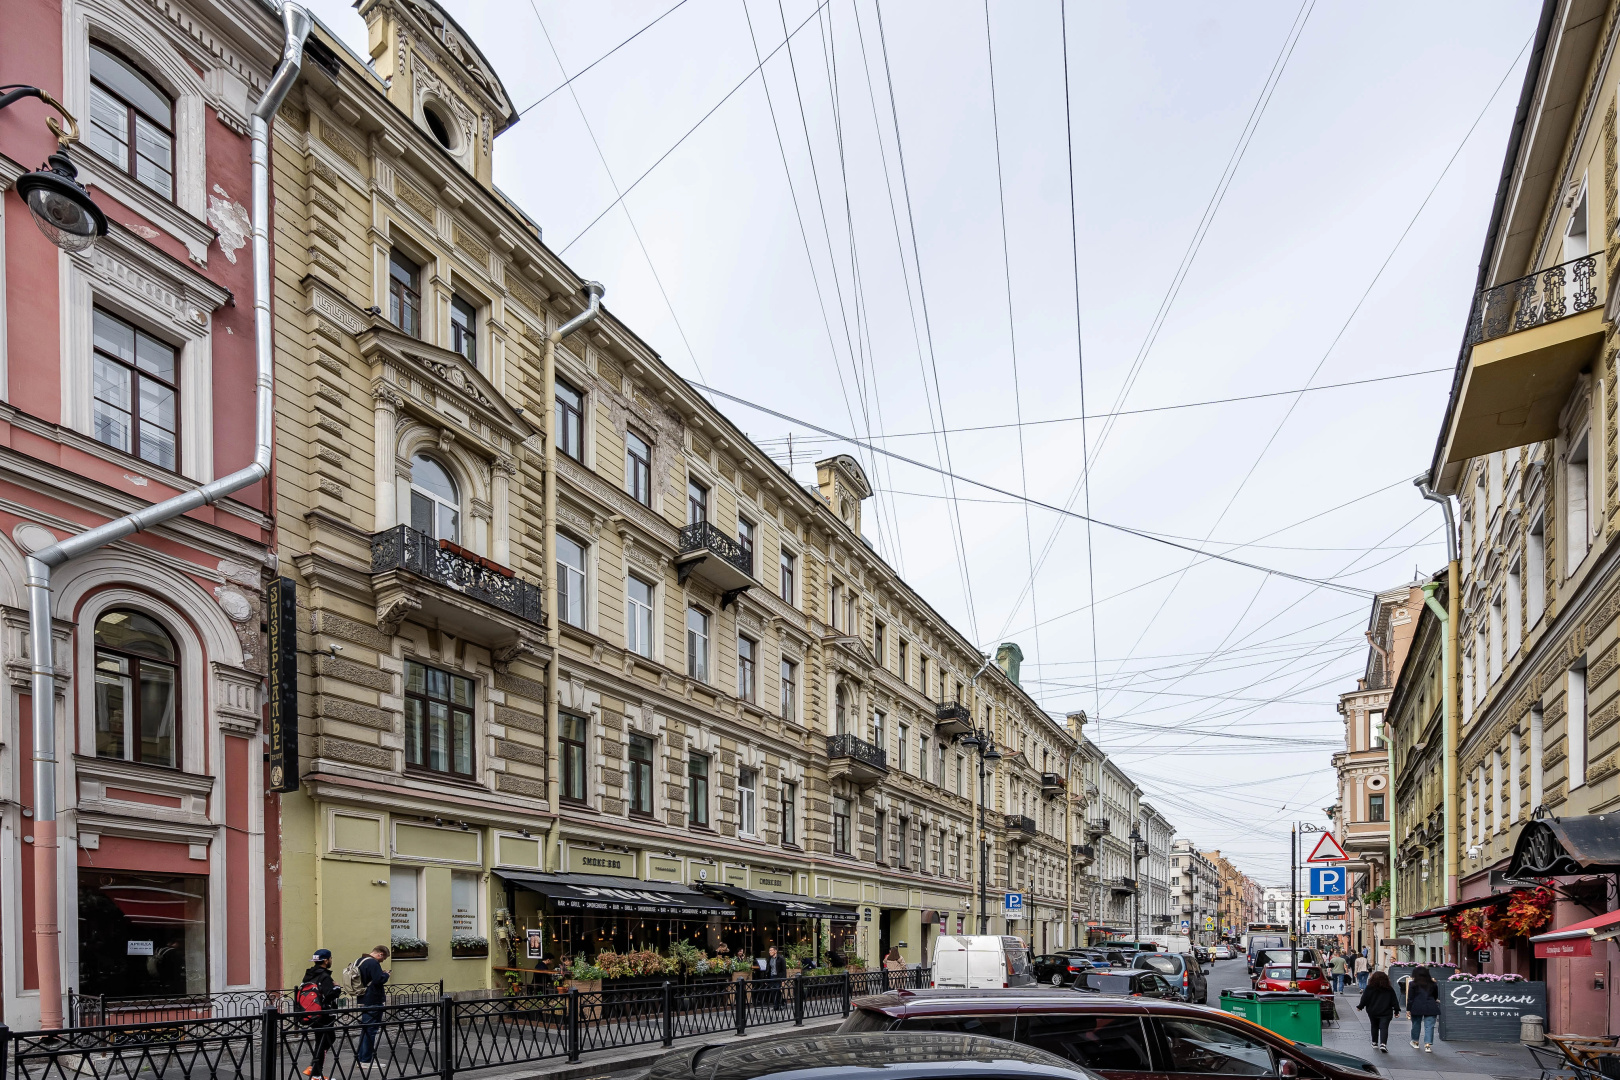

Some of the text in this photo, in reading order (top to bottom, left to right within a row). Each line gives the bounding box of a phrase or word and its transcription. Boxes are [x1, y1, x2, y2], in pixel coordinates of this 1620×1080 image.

[270, 586, 280, 750] ЗАЗЕРКАЛЬЕ
[582, 856, 621, 869] SMOKE BBQ
[1319, 870, 1339, 893] P
[1009, 895, 1019, 907] P
[1450, 984, 1535, 1006] Есенин
